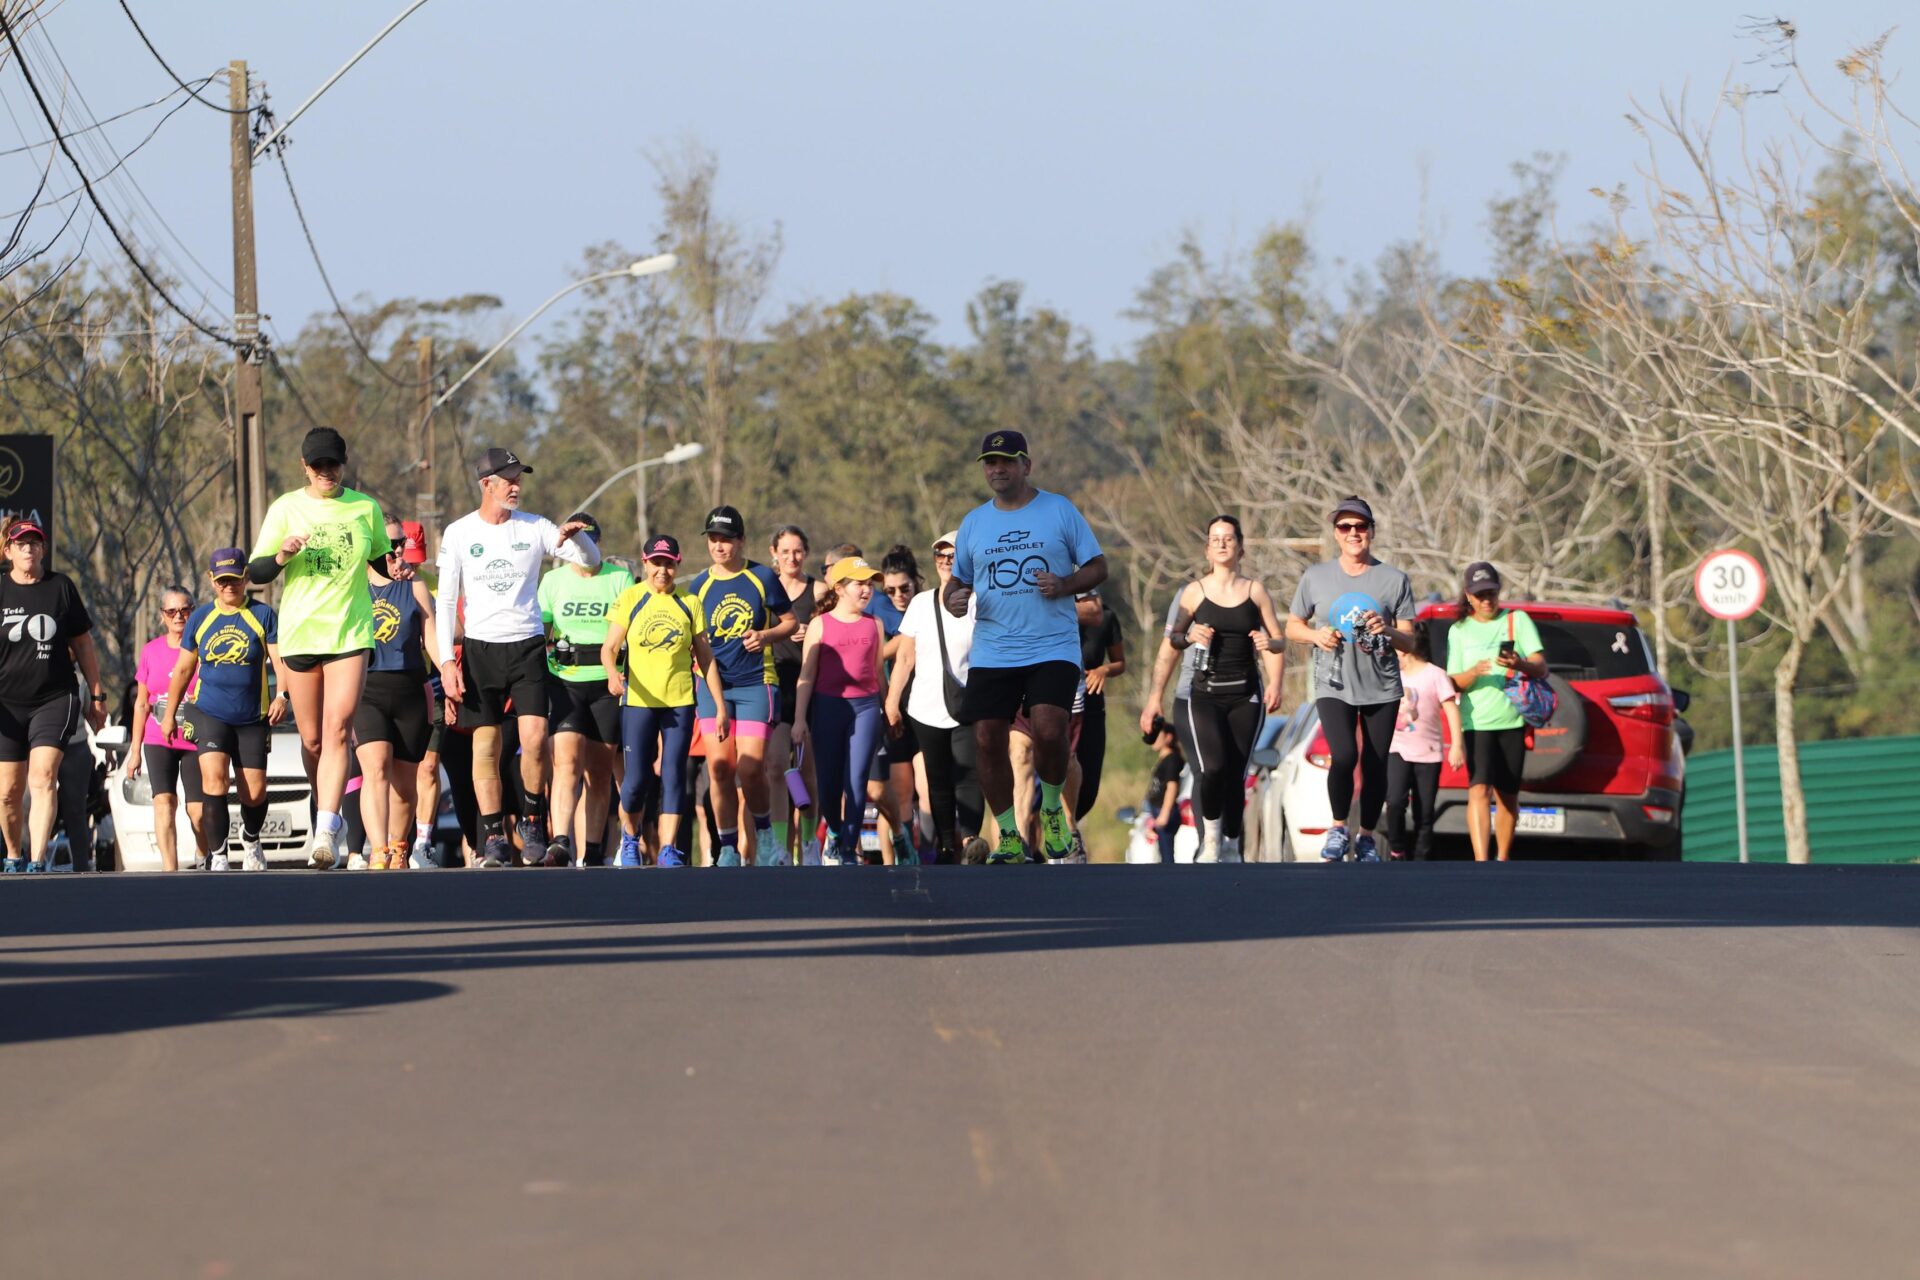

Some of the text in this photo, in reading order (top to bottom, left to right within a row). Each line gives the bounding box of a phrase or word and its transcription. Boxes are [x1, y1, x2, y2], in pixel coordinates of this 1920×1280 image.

[985, 542, 1045, 555] CHEVROLET
[988, 555, 1050, 590] 100
[1713, 565, 1745, 589] 30
[721, 597, 752, 611] RUNNERS
[1713, 593, 1747, 604] km/h
[562, 602, 609, 617] SESI
[2, 613, 57, 642] 70
